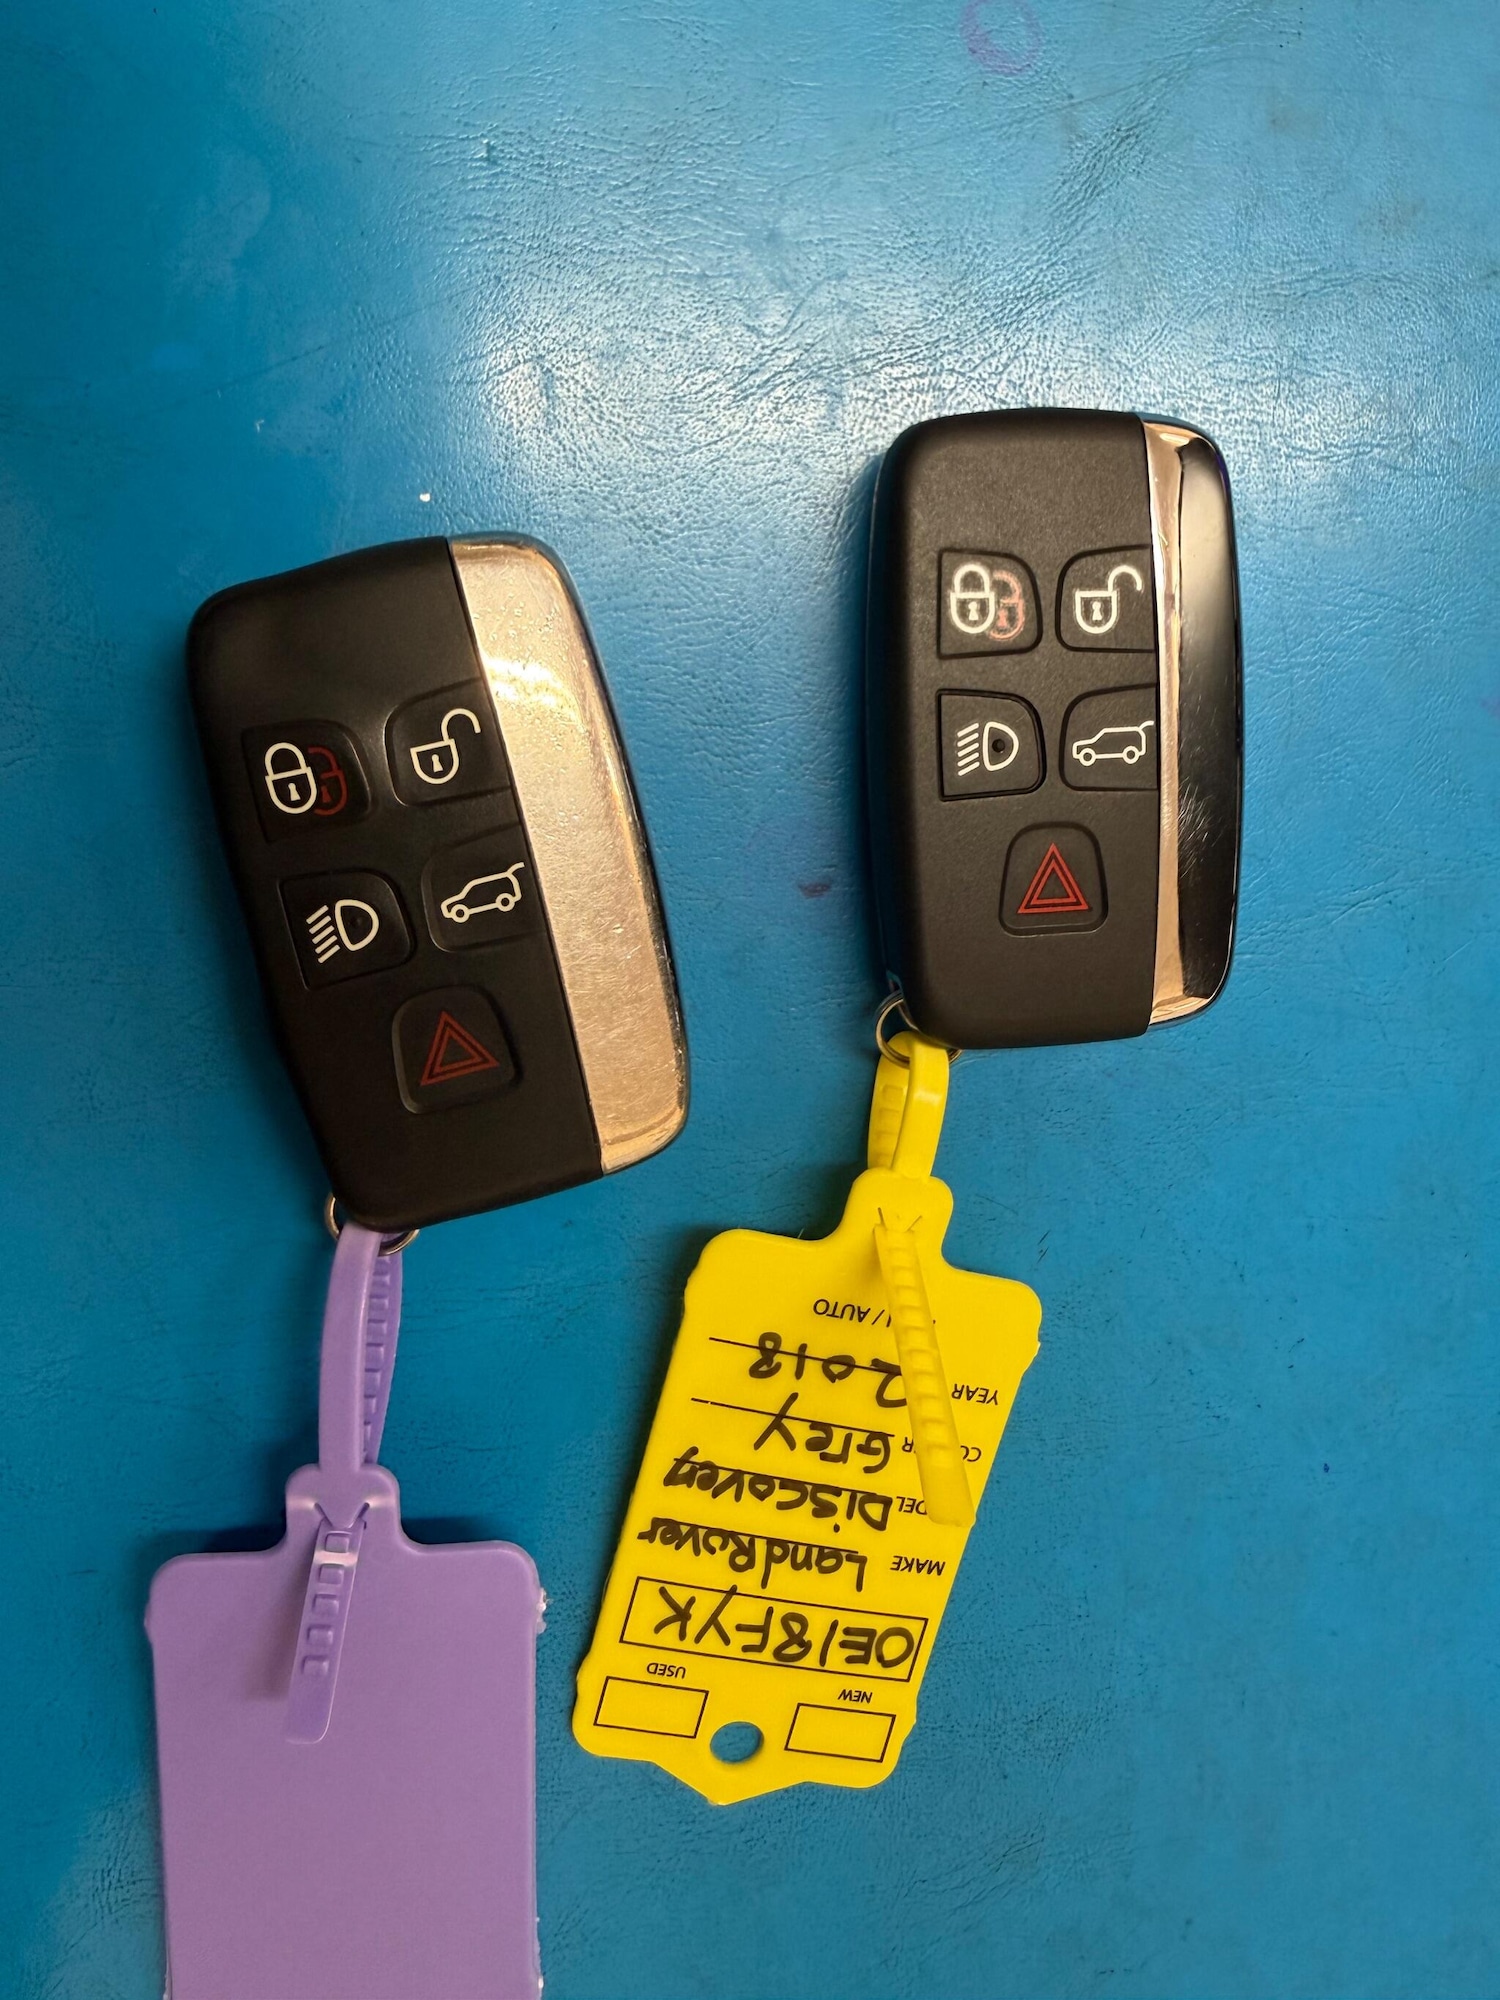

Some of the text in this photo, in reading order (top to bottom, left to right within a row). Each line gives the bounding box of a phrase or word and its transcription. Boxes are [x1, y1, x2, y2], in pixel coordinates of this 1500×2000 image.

[812, 1298, 871, 1323] AUTO
[748, 1332, 908, 1408] 2018
[951, 1383, 999, 1406] YEAR
[753, 1392, 891, 1474] Grey
[896, 1495, 929, 1516] DEL
[890, 1555, 946, 1575] MAKE
[653, 1584, 915, 1669] OE18FYK
[646, 1661, 687, 1680] USED
[837, 1688, 873, 1704] NEW
